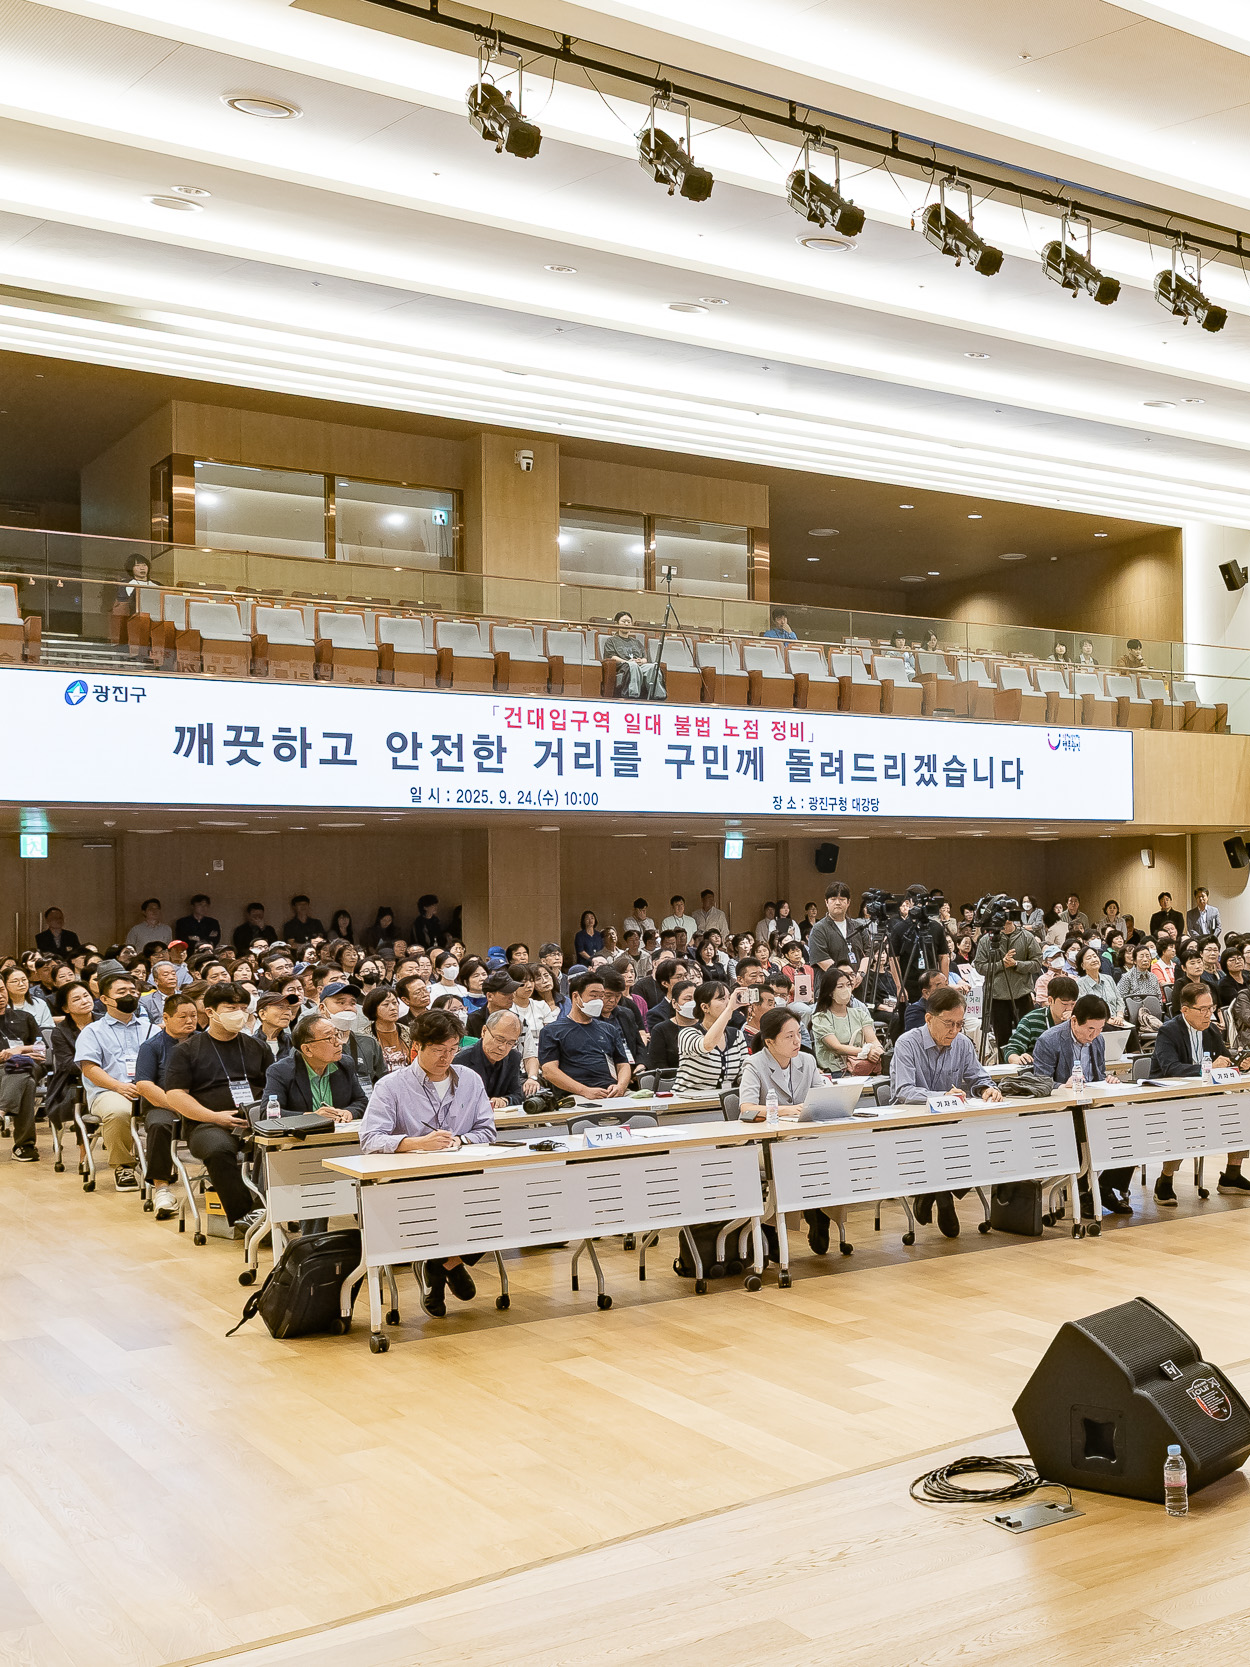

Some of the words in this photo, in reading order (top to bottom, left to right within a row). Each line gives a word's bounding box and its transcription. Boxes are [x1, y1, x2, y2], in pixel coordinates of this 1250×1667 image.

[92, 685, 147, 703] 광진구
[625, 712, 662, 736] 일대
[674, 714, 711, 738] 불법
[724, 717, 760, 740] 노점
[173, 723, 358, 768] 깨끗하고
[386, 731, 507, 773] 안전한
[534, 738, 642, 778] 거리를
[665, 743, 764, 782] 구민께
[786, 749, 1024, 789] 돌려드리겠습니다
[457, 789, 493, 804] 2025.
[499, 790, 512, 805] 9.
[565, 791, 599, 806] 10:00
[808, 796, 848, 813] 광진구청
[852, 796, 880, 813] 대강당
